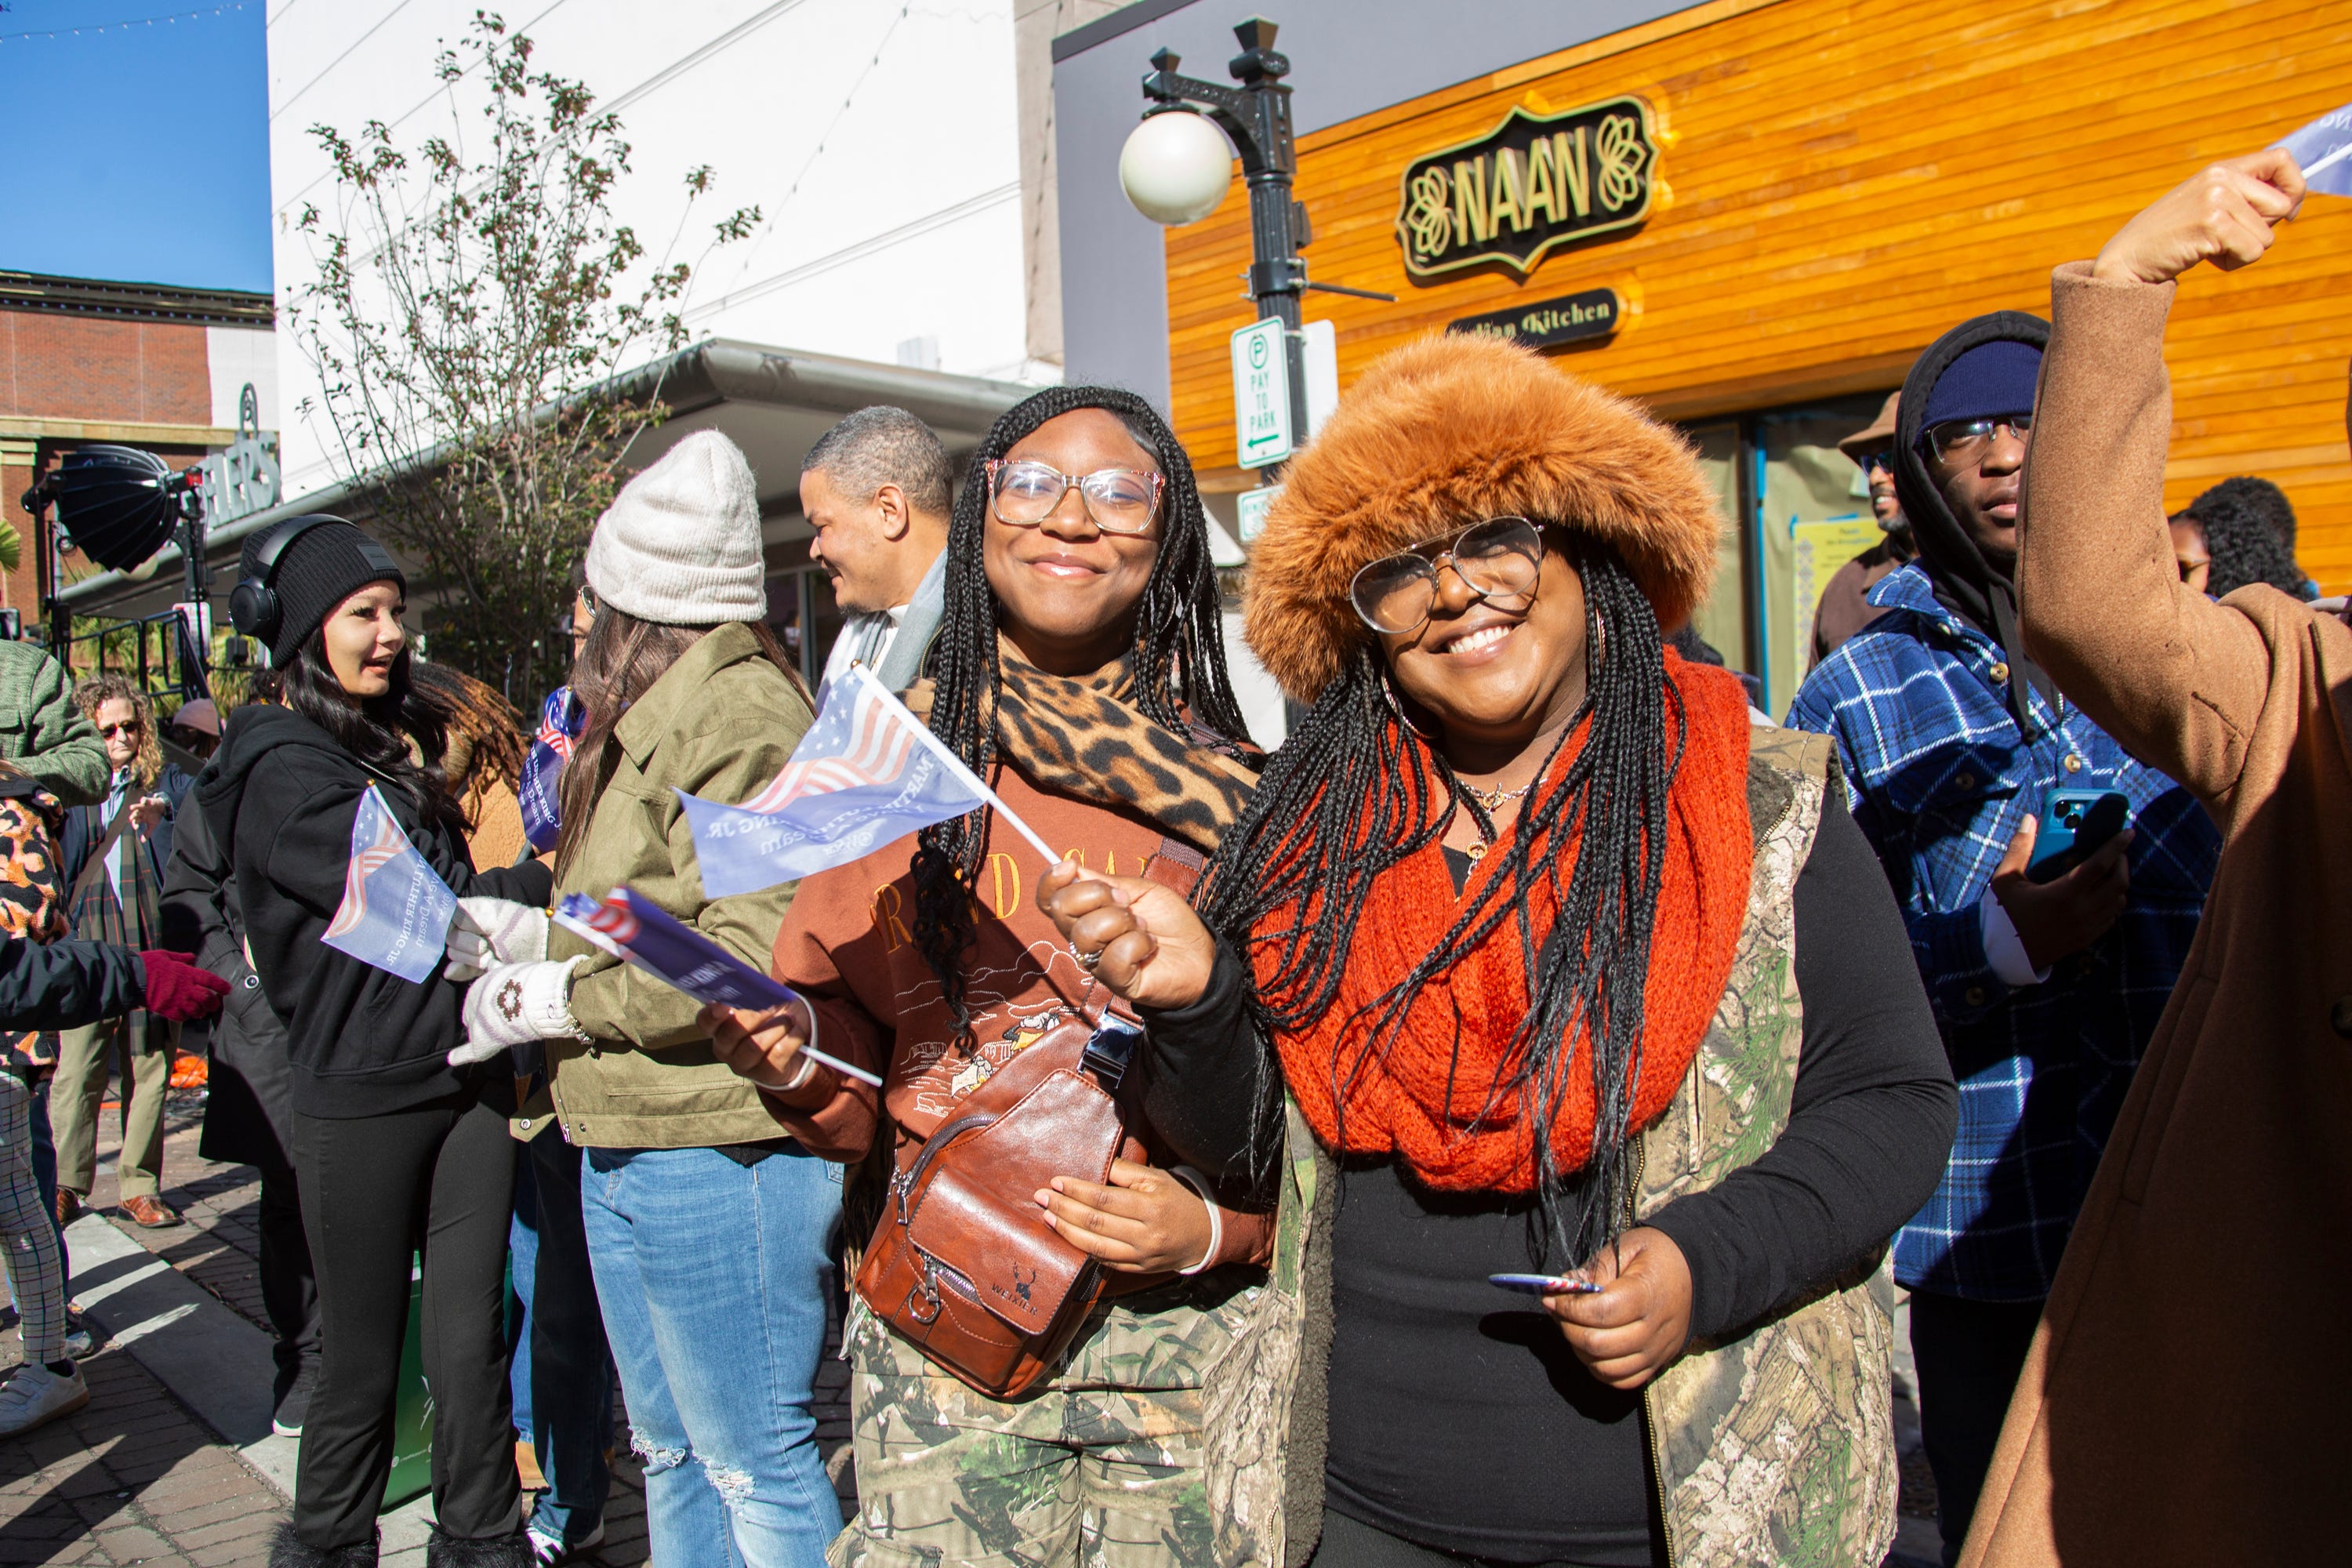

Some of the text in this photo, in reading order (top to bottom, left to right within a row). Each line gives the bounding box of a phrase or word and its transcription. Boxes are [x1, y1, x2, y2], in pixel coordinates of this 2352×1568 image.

[1453, 126, 1590, 247] NAAN
[1521, 303, 1610, 336] Kitchen
[1250, 371, 1269, 390] PAY
[1256, 393, 1269, 412] TO
[1250, 410, 1277, 434] PARK
[528, 788, 542, 826] Dream
[532, 757, 543, 798] LUTHER
[539, 796, 556, 824] KING
[991, 1283, 1038, 1316] WEIXIER
